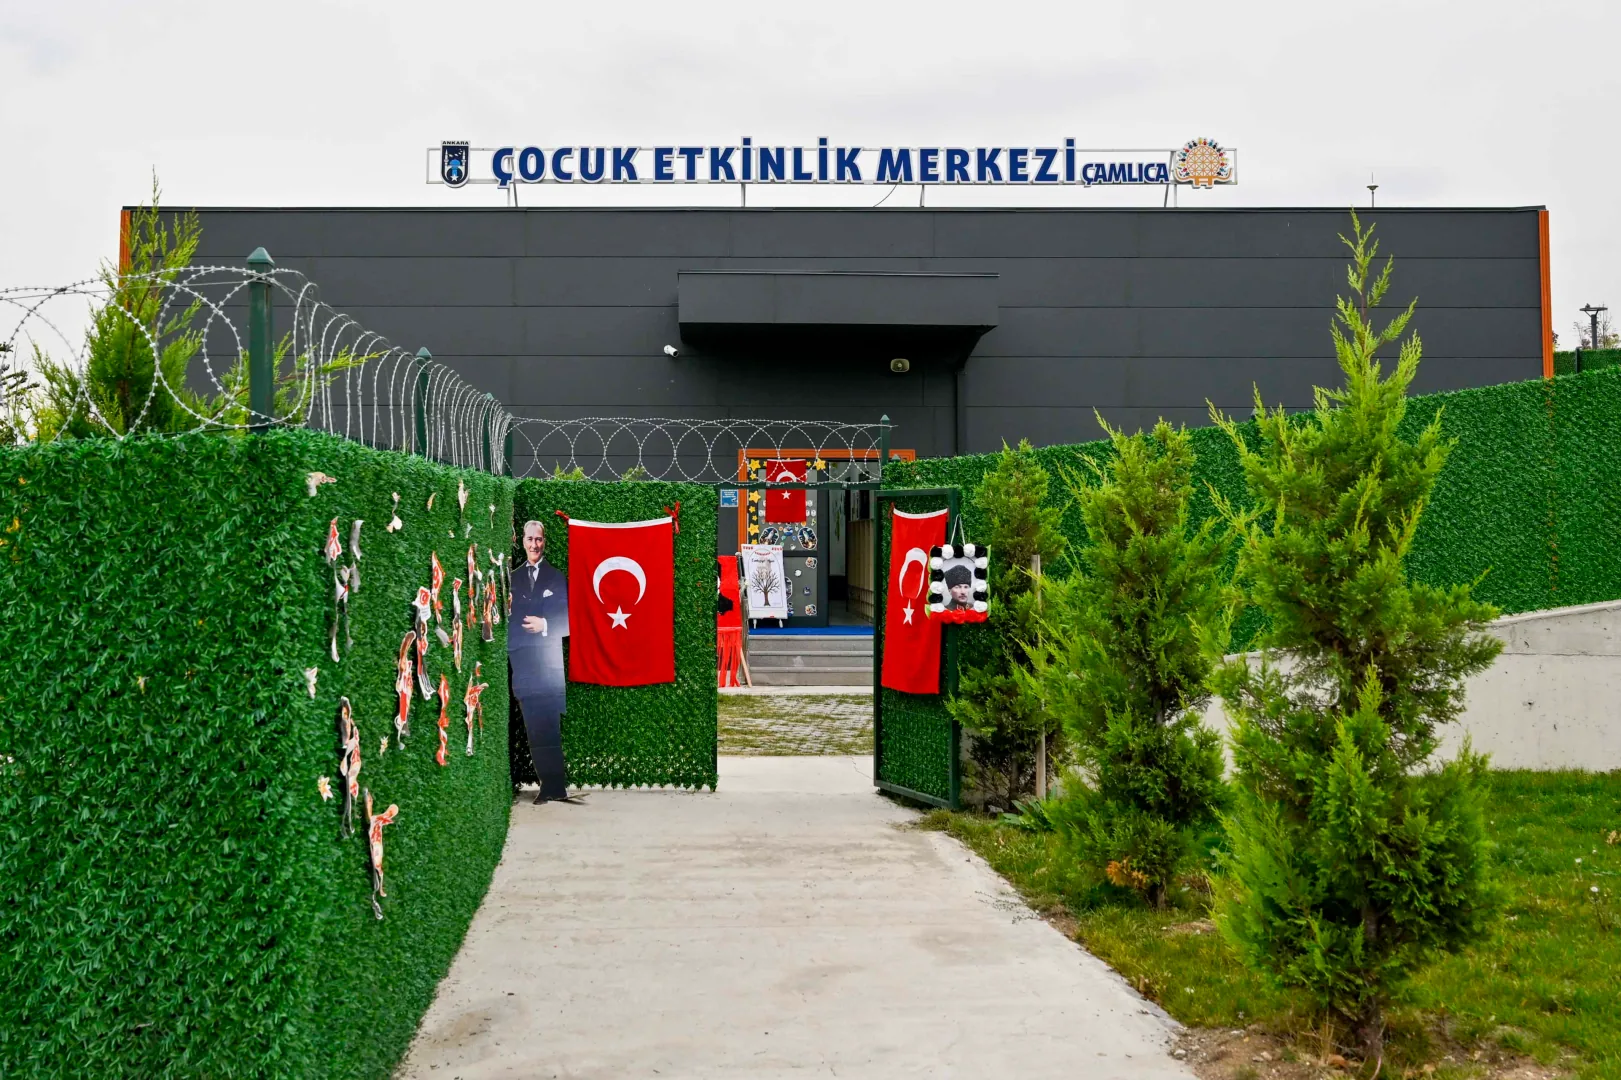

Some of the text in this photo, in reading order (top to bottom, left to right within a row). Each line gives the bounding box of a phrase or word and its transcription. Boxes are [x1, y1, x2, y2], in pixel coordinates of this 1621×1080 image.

[492, 137, 1169, 187] ÇOCUK ETKİNLİK MERKEZİ ÇAMLICA
